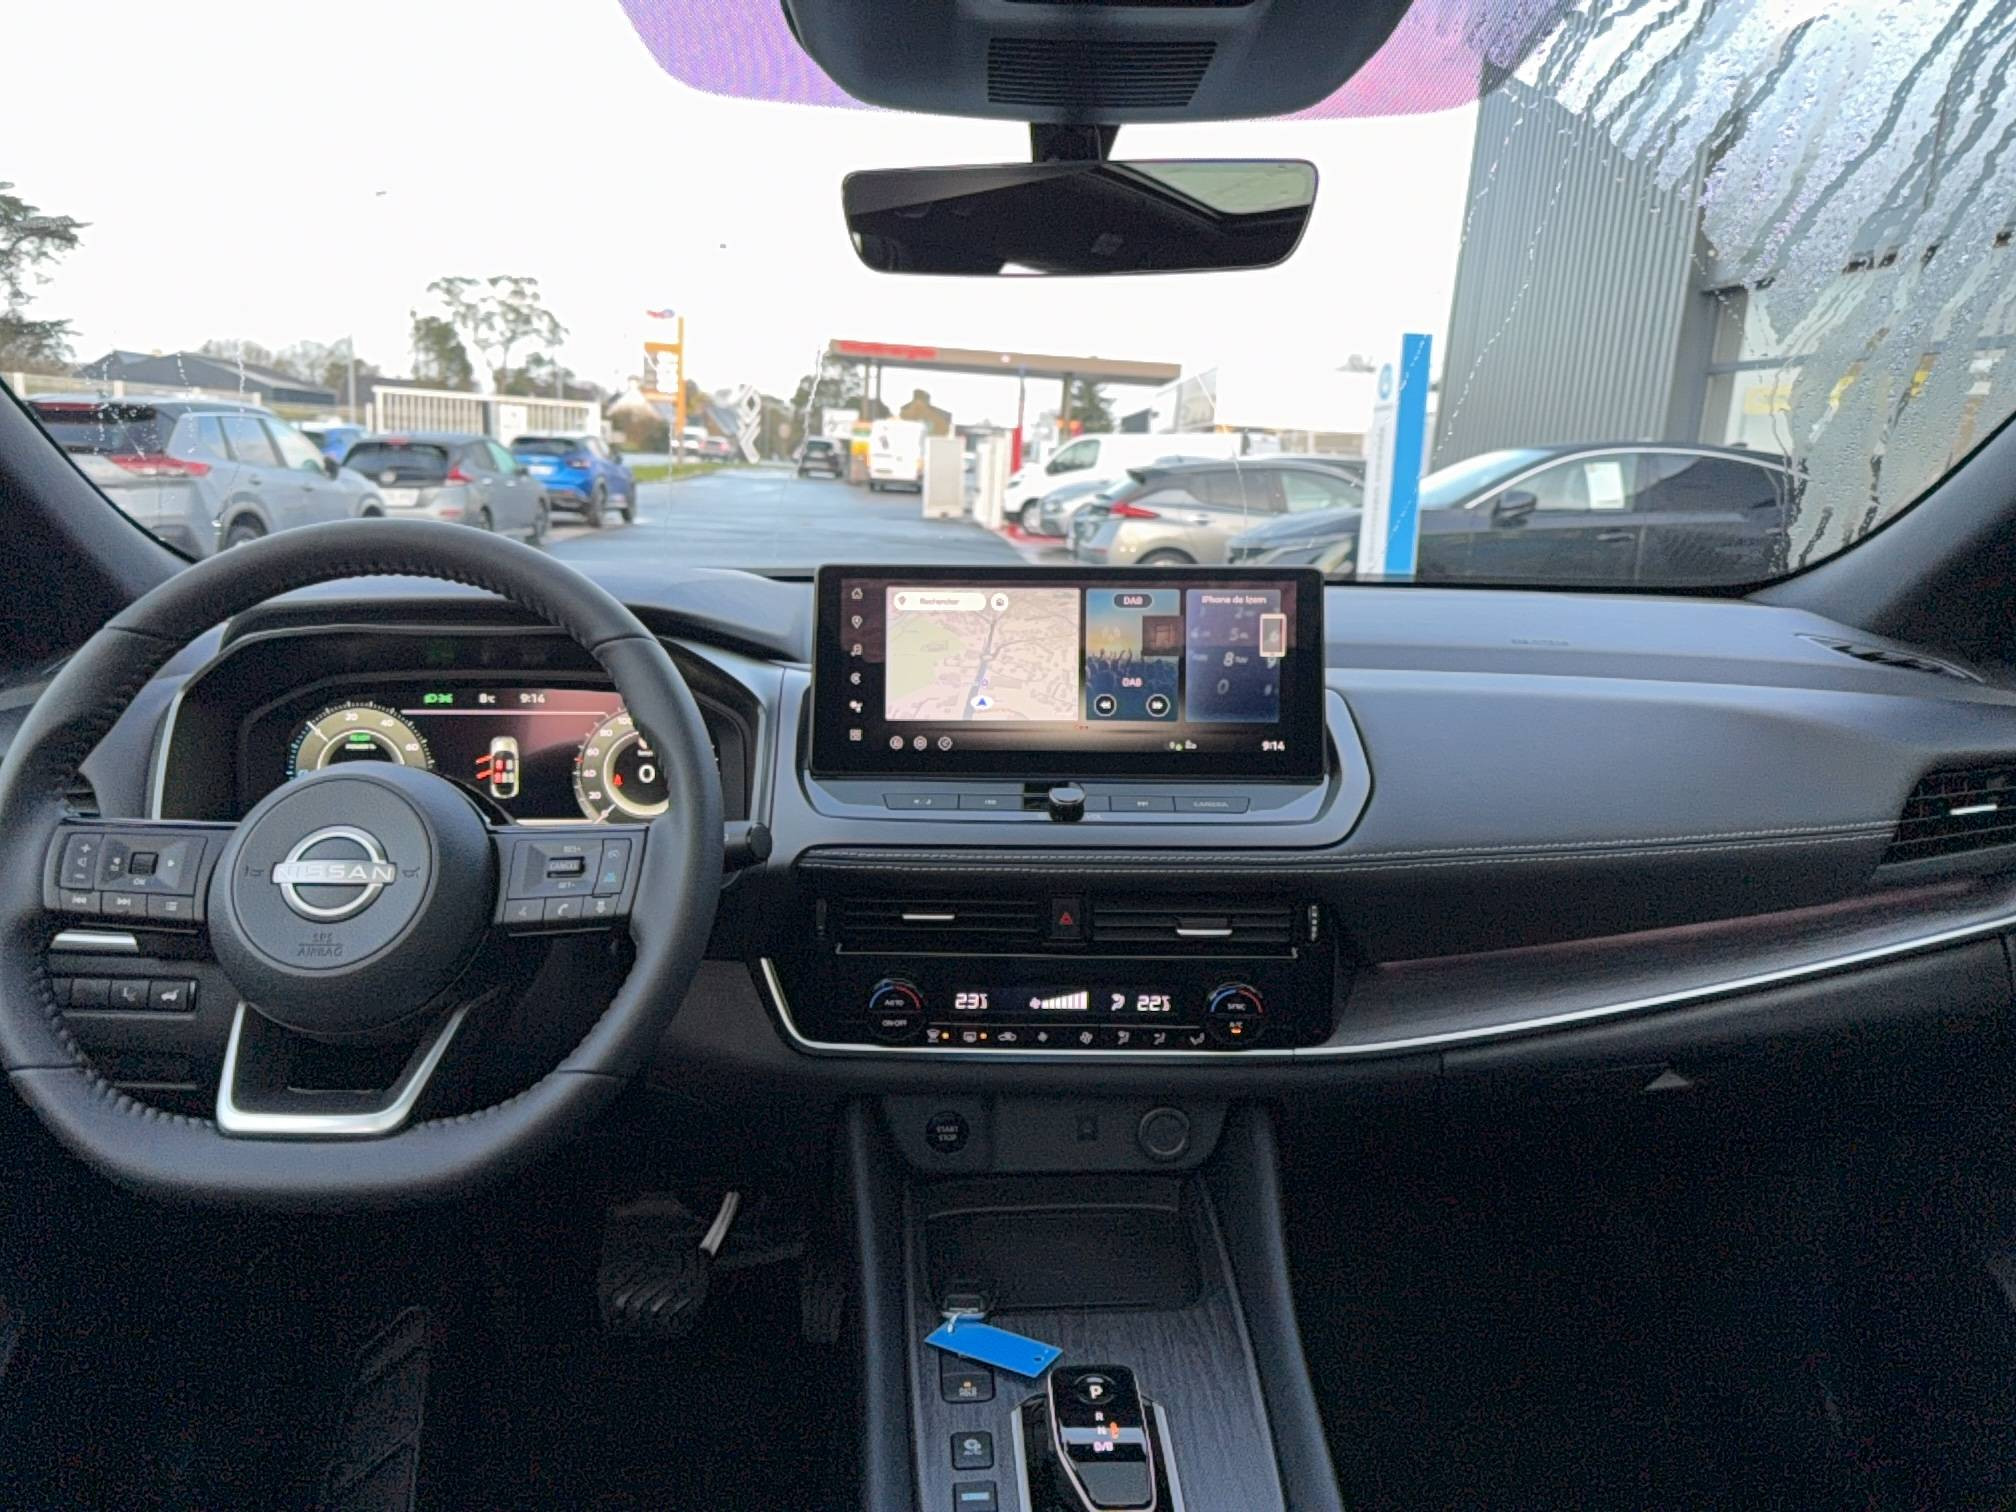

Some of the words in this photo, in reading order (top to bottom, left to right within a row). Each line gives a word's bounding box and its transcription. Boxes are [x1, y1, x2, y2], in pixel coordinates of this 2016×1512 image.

[1123, 596, 1143, 605] DAB
[1122, 677, 1143, 688] DAB
[1262, 740, 1285, 751] 9:14
[639, 764, 656, 783] 0
[276, 865, 393, 881] NISSAN
[1089, 1384, 1103, 1400] P
